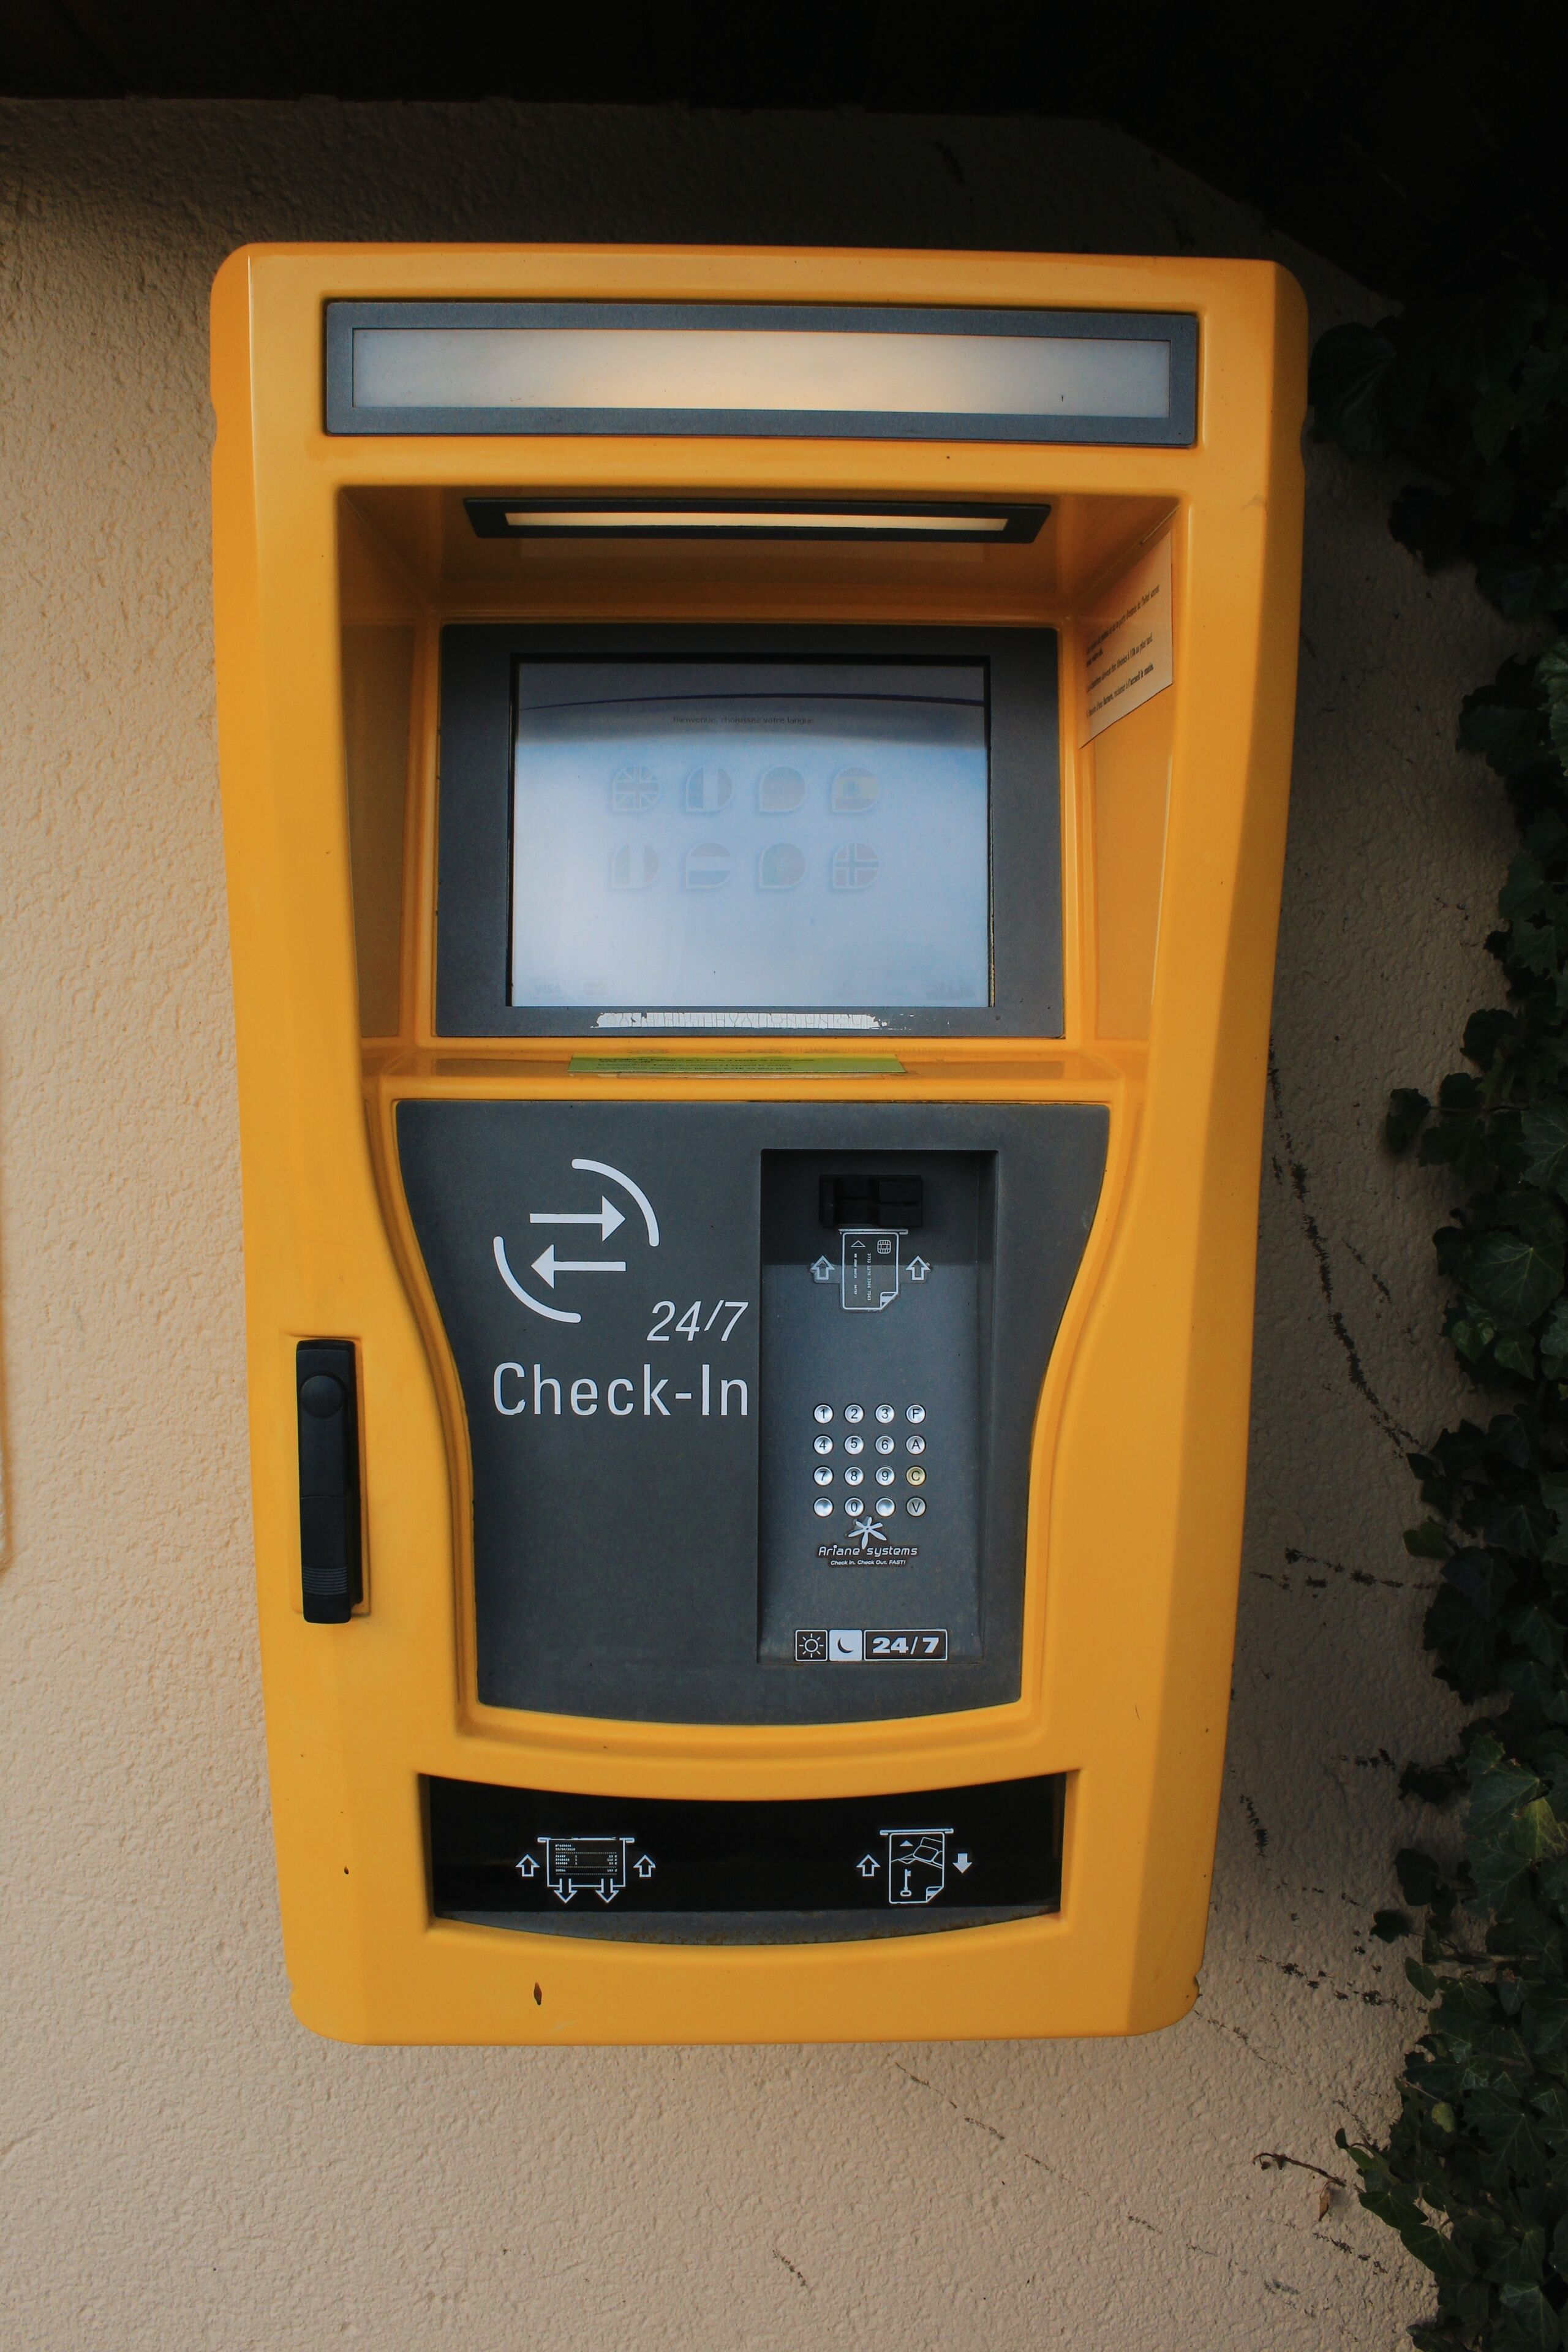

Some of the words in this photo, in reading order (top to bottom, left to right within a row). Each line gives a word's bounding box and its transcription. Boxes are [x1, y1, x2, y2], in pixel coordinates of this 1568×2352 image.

[788, 717, 814, 725] langue
[646, 1300, 749, 1341] 24/7
[493, 1362, 748, 1416] Check-In
[821, 1409, 826, 1419] 1
[851, 1409, 858, 1419] 2
[881, 1409, 888, 1419] 3
[913, 1409, 920, 1419] F
[819, 1440, 826, 1450] 4
[851, 1438, 858, 1448] 5
[881, 1440, 888, 1450] 6
[911, 1439, 921, 1450] A
[820, 1471, 826, 1481] 7
[851, 1471, 858, 1481] 8
[882, 1471, 889, 1481] 9
[911, 1471, 920, 1481] C
[851, 1502, 858, 1512] 0
[912, 1502, 921, 1512] V
[818, 1545, 860, 1556] Ariane
[867, 1546, 918, 1557] systems
[872, 1636, 940, 1654] 24/7
